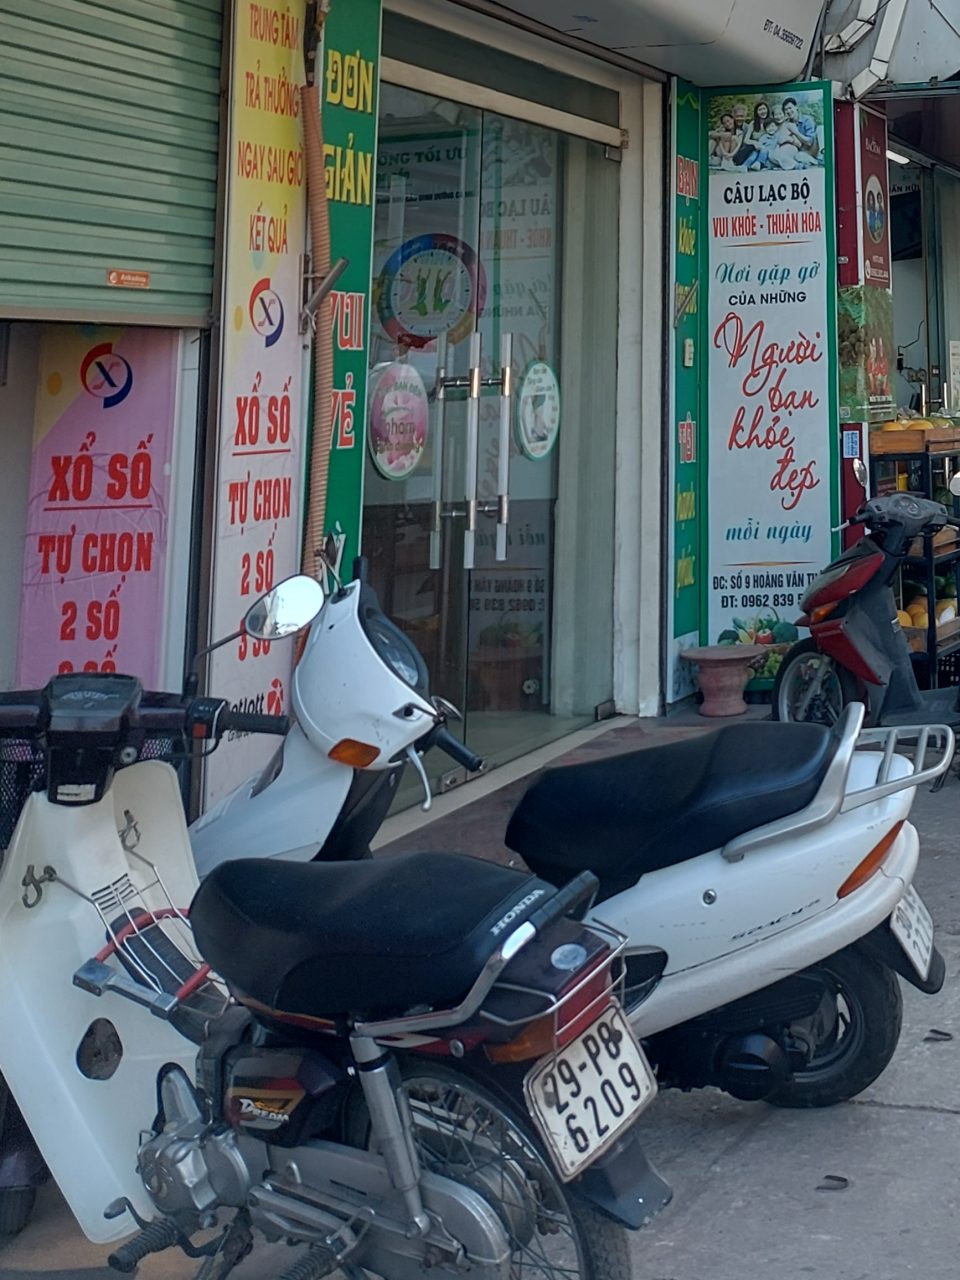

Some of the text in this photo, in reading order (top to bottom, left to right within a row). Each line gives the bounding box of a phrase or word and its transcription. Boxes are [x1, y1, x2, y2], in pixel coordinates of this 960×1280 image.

[249, 2, 300, 52] TRUNG TÂM
[245, 59, 300, 119] TRẢ THƯỞNG
[326, 48, 374, 114] ĐƠN
[237, 140, 266, 179] NGAY
[267, 145, 286, 187] SAU
[723, 176, 811, 207] CÂU LẠC BỘ
[248, 201, 289, 255] KẾT QUẢ
[712, 216, 729, 238] VUI
[731, 208, 757, 238] KHỎE
[766, 208, 799, 239] THUẬN
[801, 206, 822, 233] HÒA
[715, 261, 821, 287] Nơi gặp gỡ
[728, 289, 807, 306] CỦA NHỮNG
[713, 311, 823, 398] Người
[234, 371, 292, 447] XỔ SỐ
[768, 368, 820, 417] bạn
[728, 405, 796, 451] khỏe
[48, 431, 154, 502] XỔ SỐ
[769, 446, 820, 510] đẹp
[228, 471, 292, 536] TỰ CHỌN
[38, 524, 154, 585] TỰ CHỌN
[725, 517, 813, 545] mỗi ngày
[240, 552, 251, 596] 2
[712, 575, 728, 590] ĐC:
[730, 569, 743, 590] SỐ
[745, 575, 751, 589] 9
[752, 570, 784, 589] HOÀNG
[785, 570, 805, 588] VĂN
[60, 583, 123, 641] 2 SỐ
[721, 595, 738, 609] ĐT:
[741, 593, 770, 608] 0962
[772, 593, 794, 607] 839
[490, 888, 546, 938] HONDA
[547, 1020, 622, 1116] 29-P8
[564, 1062, 641, 1155] 6209
